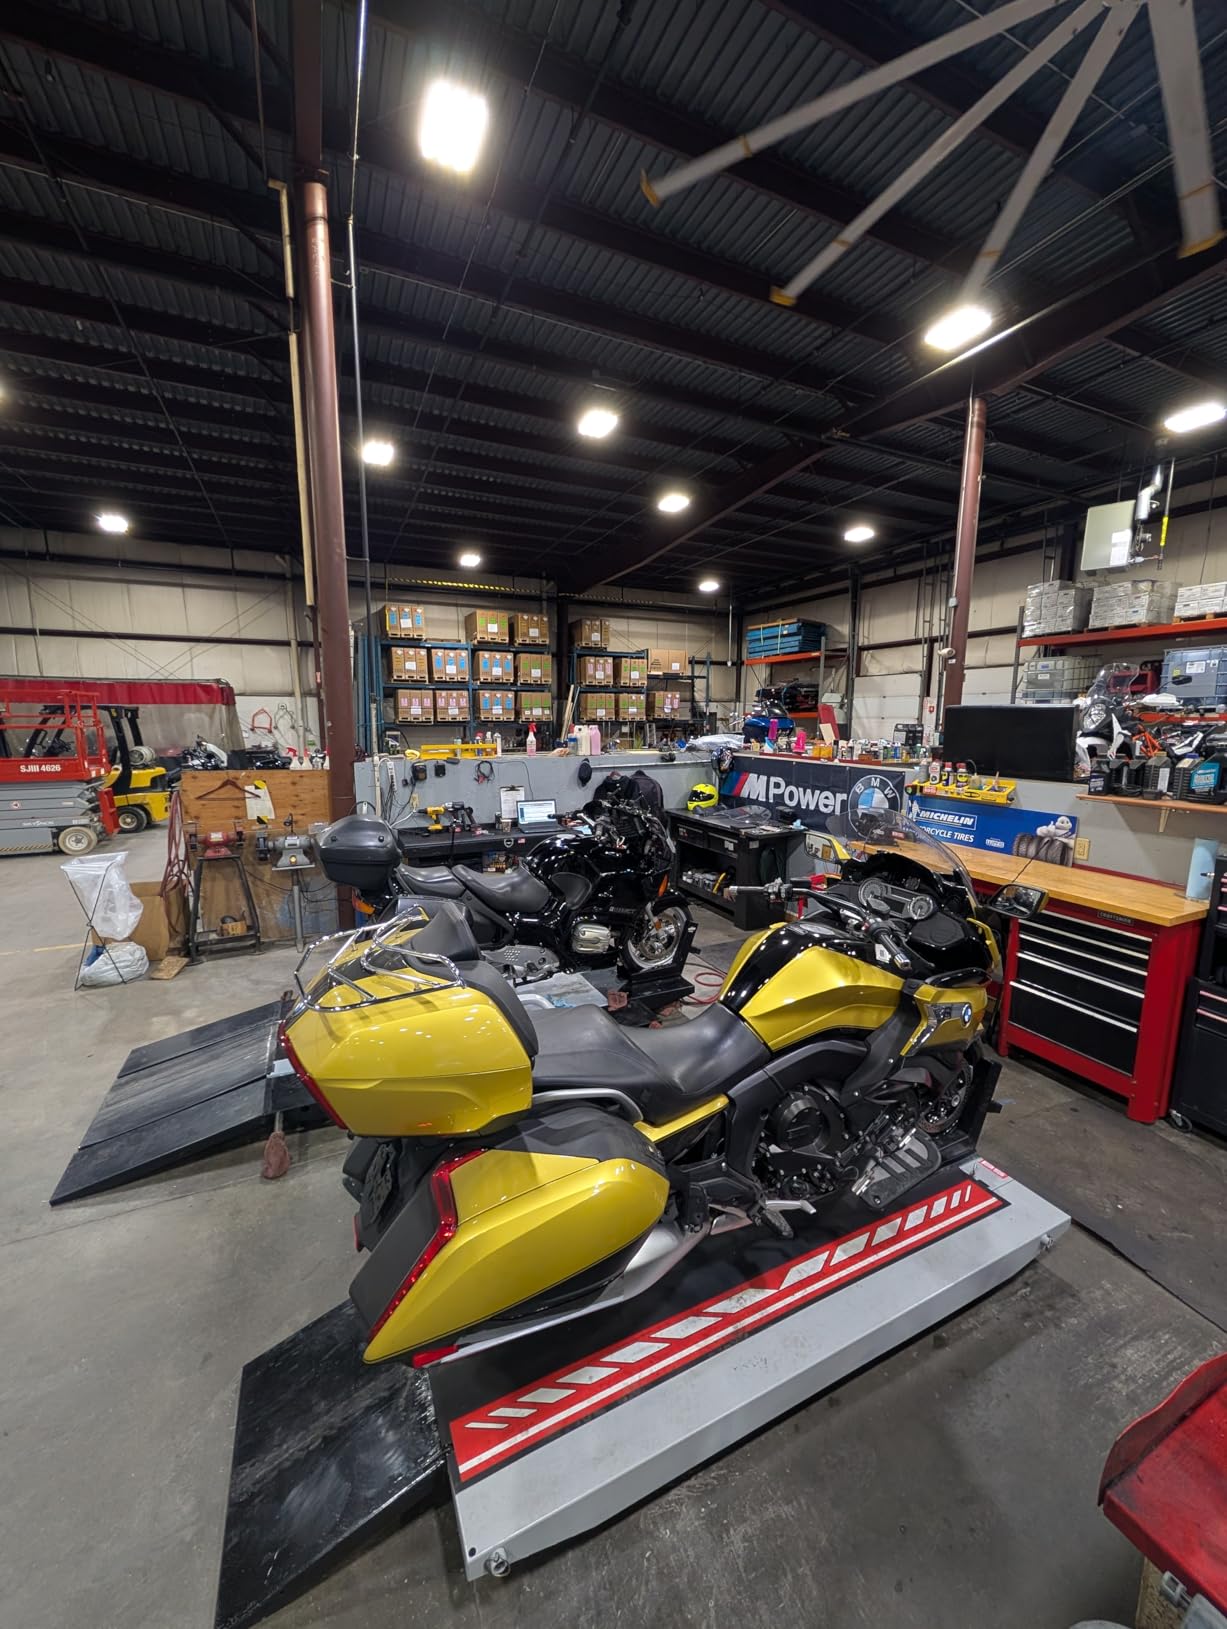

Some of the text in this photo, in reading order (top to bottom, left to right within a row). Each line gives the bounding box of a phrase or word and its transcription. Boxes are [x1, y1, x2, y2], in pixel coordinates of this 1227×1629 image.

[40, 764, 61, 772] 4626
[919, 810, 975, 826] MICHELIN
[953, 832, 975, 843] TIRES
